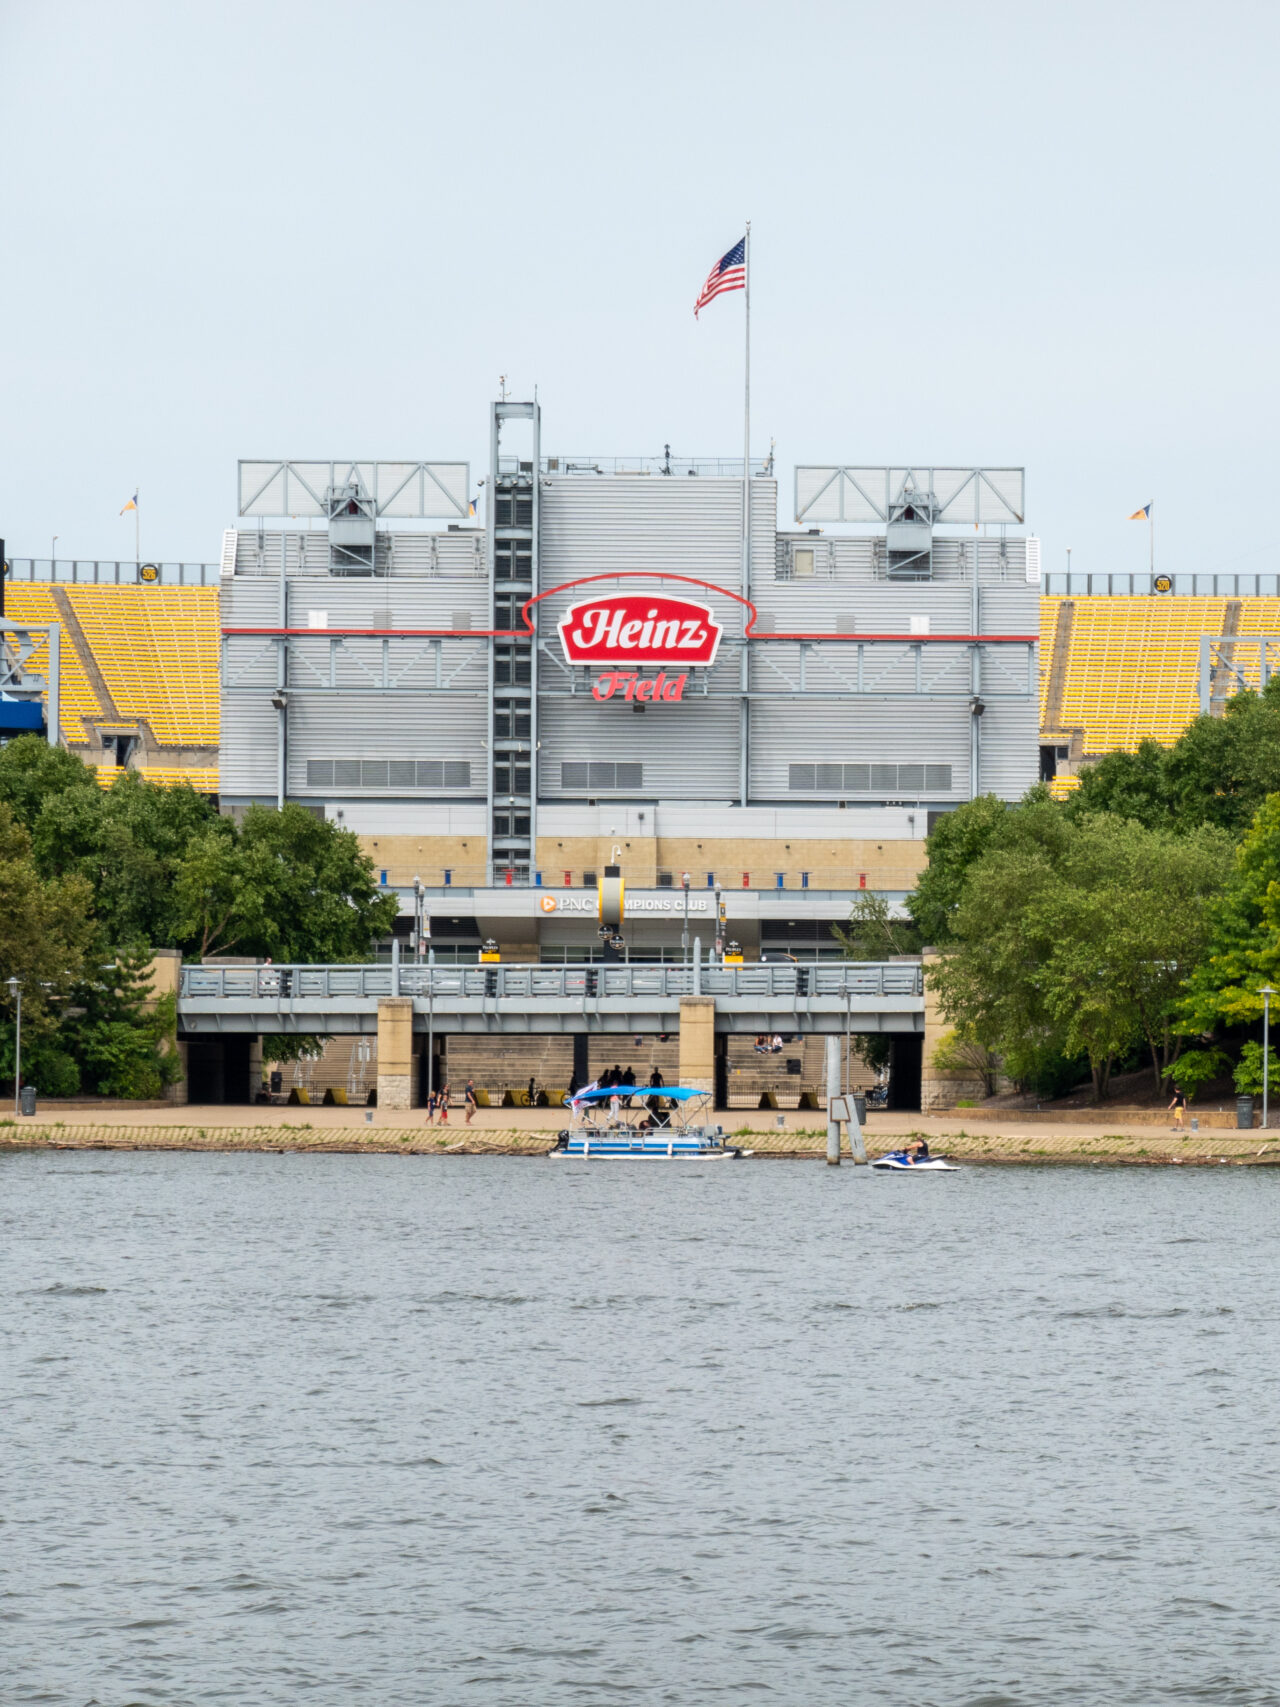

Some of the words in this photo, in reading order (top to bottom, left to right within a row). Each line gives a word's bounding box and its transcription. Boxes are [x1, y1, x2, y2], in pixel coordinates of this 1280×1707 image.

[1157, 580, 1170, 591] 520
[572, 609, 708, 649] Heinz
[592, 671, 688, 702] Field
[559, 897, 594, 911] PNC
[674, 899, 707, 911] CLUB
